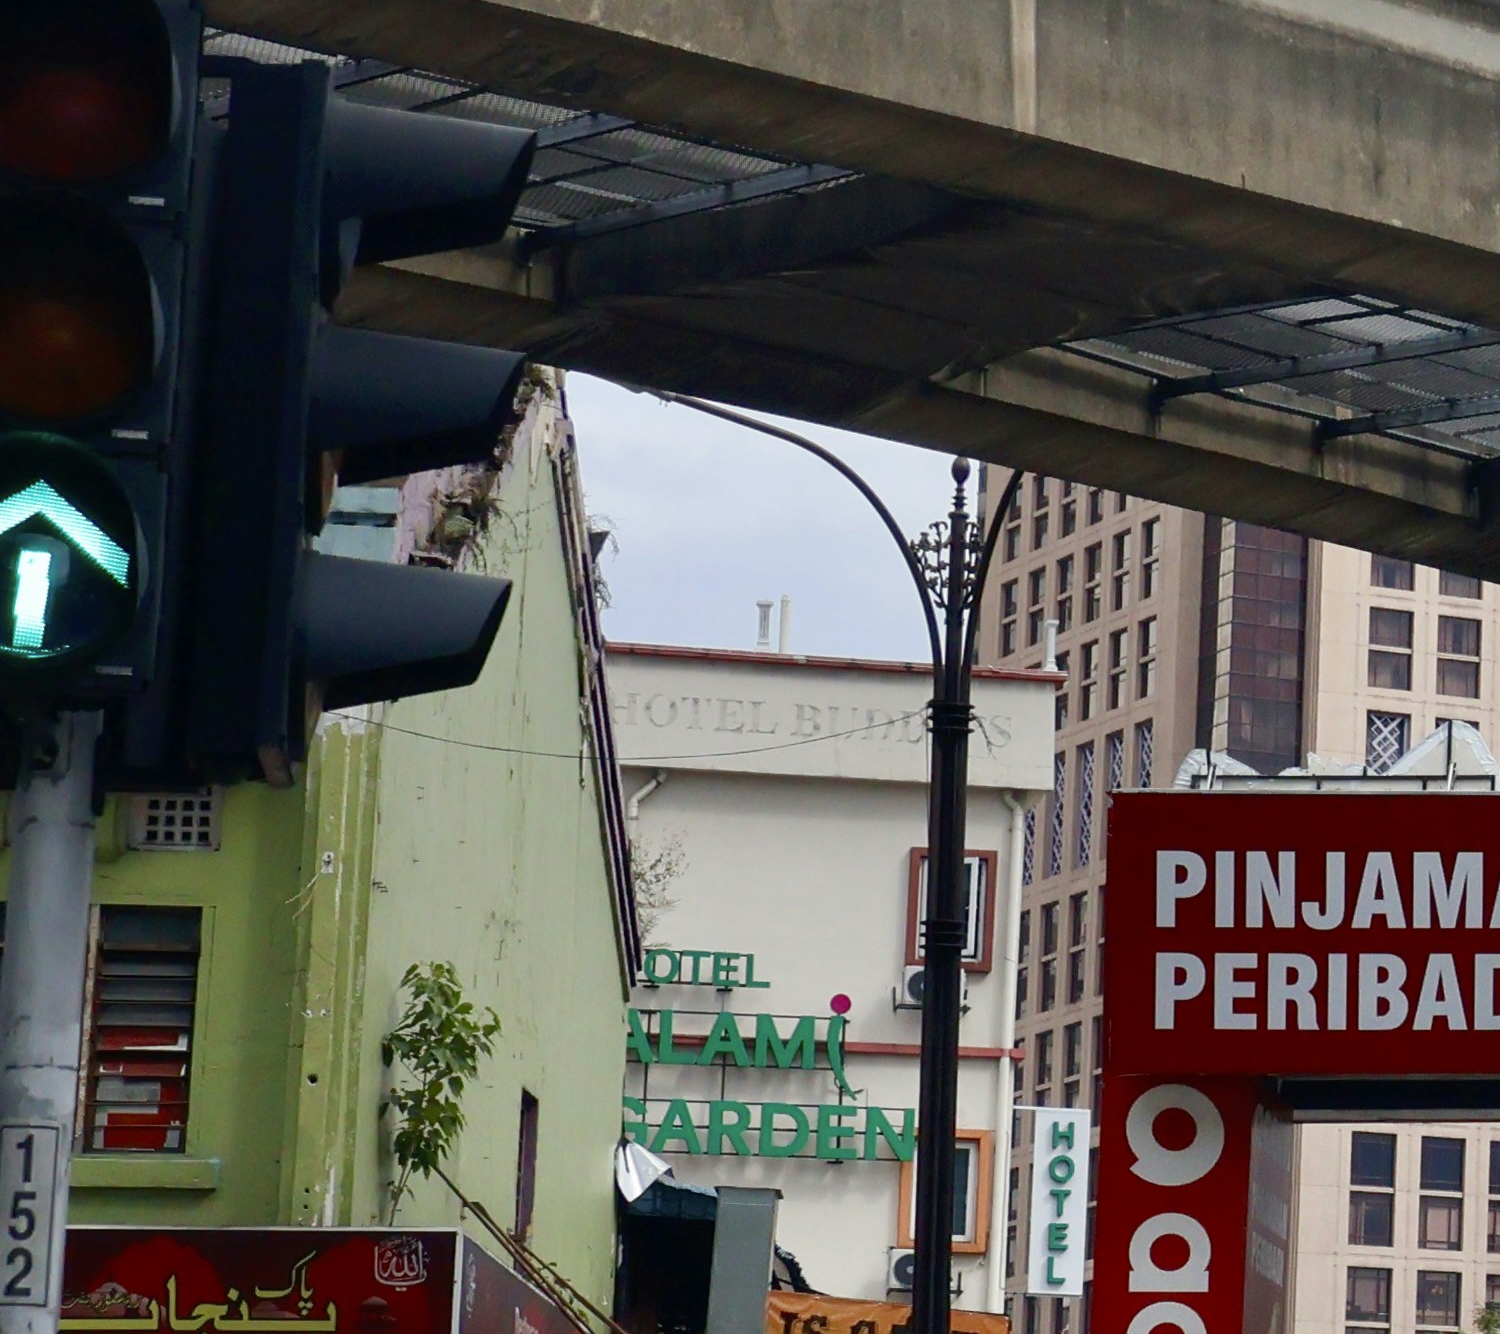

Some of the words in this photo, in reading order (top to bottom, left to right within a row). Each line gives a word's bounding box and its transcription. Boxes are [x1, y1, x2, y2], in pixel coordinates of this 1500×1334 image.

[644, 948, 770, 988] OTEL
[622, 1096, 915, 1161] GARDEN
[1046, 1121, 1075, 1286] HOTEL
